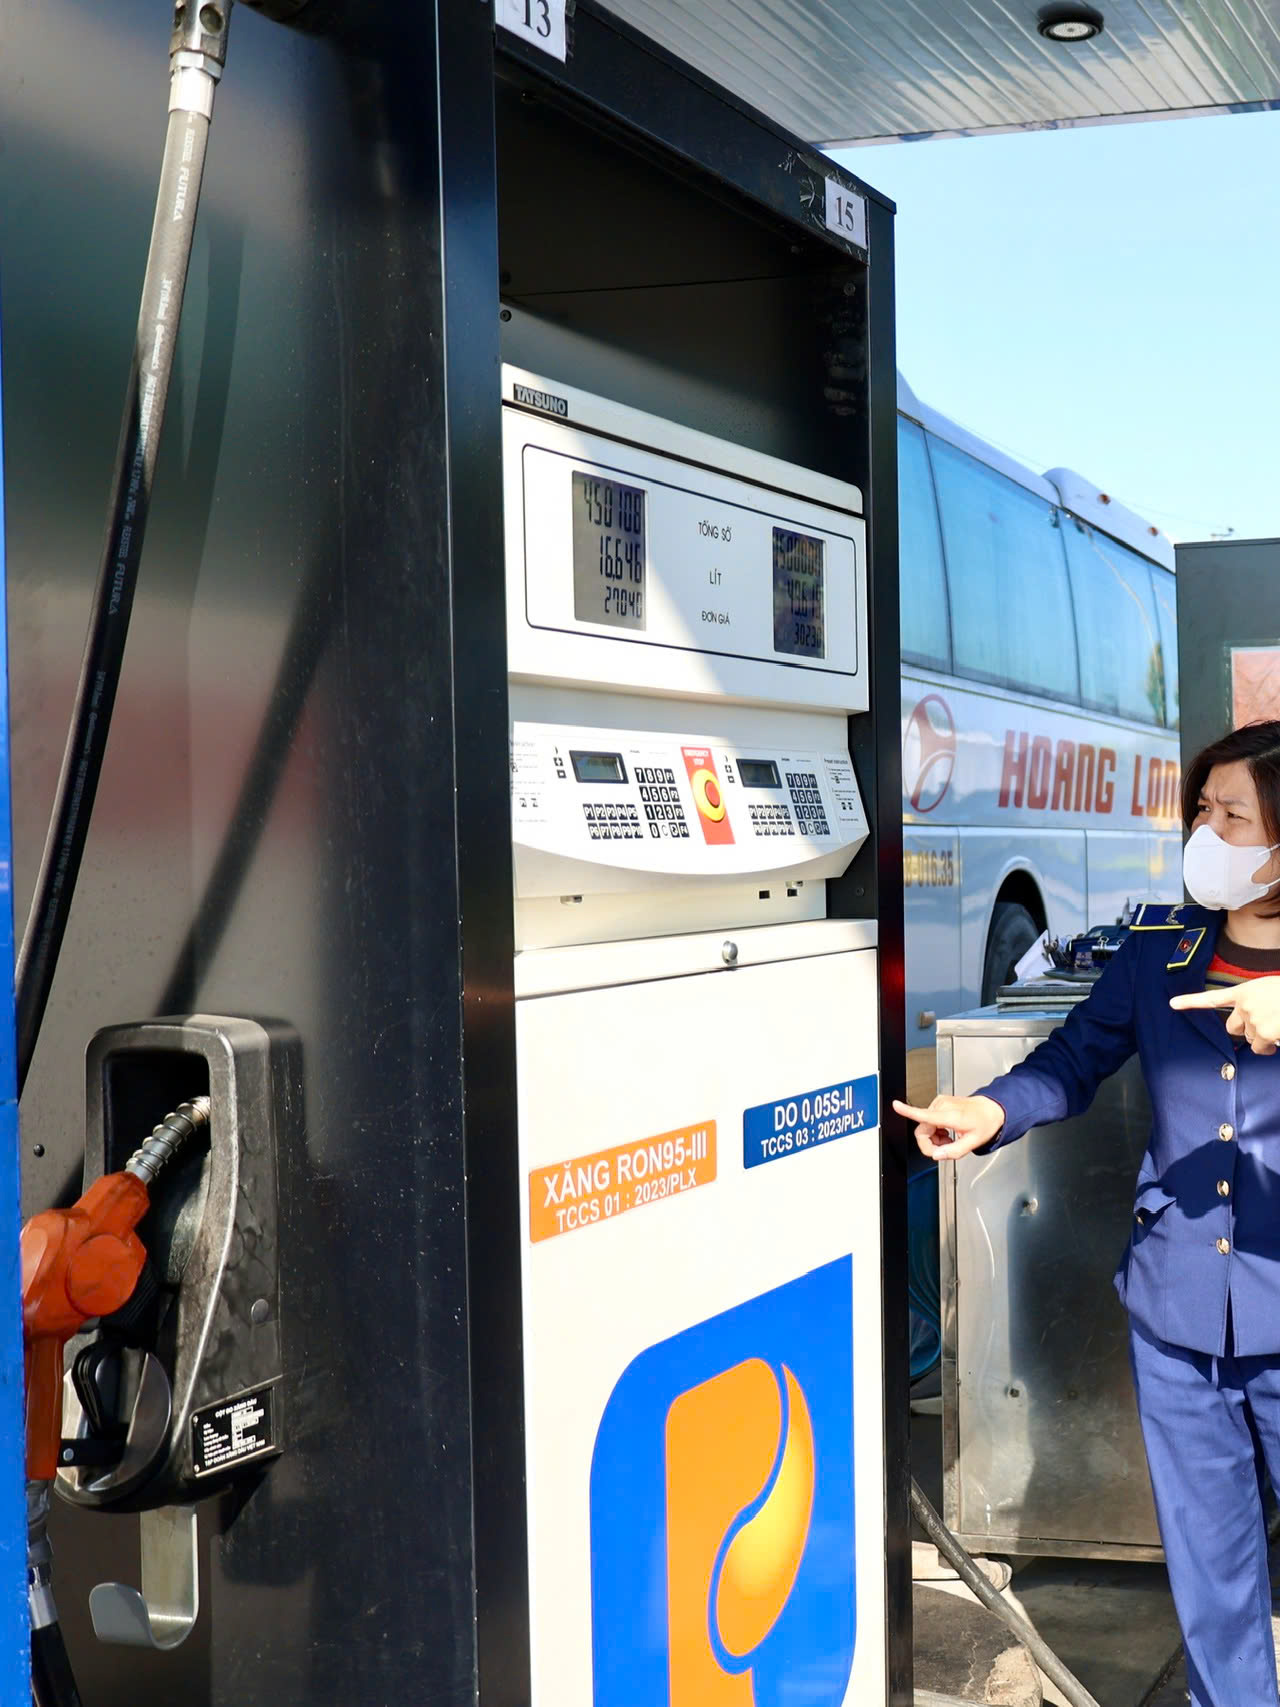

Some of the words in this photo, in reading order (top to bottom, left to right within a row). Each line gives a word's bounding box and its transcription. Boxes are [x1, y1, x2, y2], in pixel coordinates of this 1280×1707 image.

[835, 196, 854, 231] 15
[516, 386, 567, 415] TATSUNO
[600, 536, 642, 584] 16,646
[709, 568, 722, 586] LÍT
[604, 586, 642, 619] 27040
[646, 769, 655, 783] 8
[656, 769, 665, 783] 9
[997, 729, 1117, 814] HOANG
[651, 787, 659, 800] 5
[661, 787, 669, 800] 6
[655, 806, 665, 819] 2
[666, 806, 674, 819] 3
[661, 825, 668, 836] C
[774, 1102, 799, 1131] DO
[801, 1086, 853, 1127] 0,05S-II
[761, 1132, 793, 1158] TCCS
[795, 1127, 809, 1147] 03
[817, 1110, 865, 1143] 2023/PLX
[543, 1160, 610, 1208] XĂNG
[617, 1130, 707, 1185] RON95-III
[556, 1198, 600, 1232] TCCS
[604, 1192, 621, 1217] 01
[634, 1167, 697, 1203] 2023/PLX
